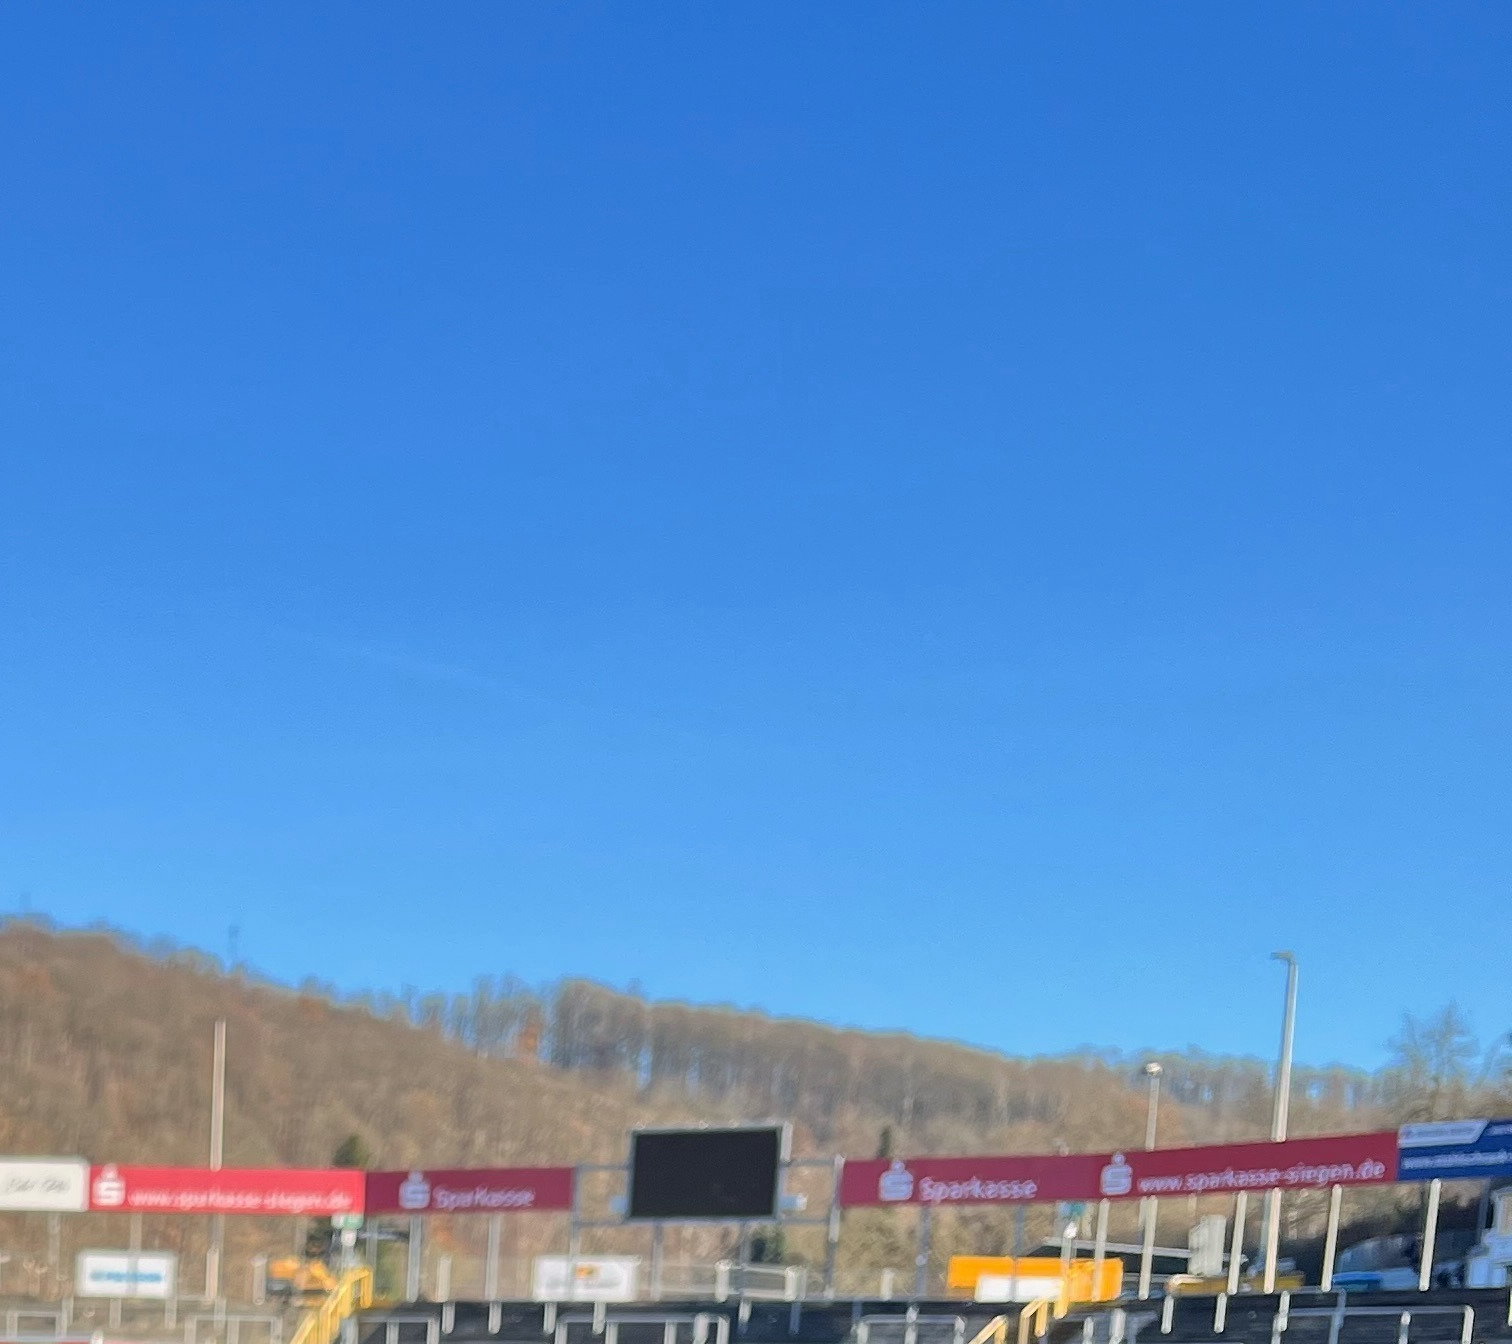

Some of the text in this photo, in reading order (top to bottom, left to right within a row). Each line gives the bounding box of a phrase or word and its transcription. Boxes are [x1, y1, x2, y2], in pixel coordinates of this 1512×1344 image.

[918, 1176, 1037, 1204] Sparkasse
[1140, 1159, 1386, 1193] www.sparkasse-siegen.de
[433, 1185, 535, 1211] Sparkasse
